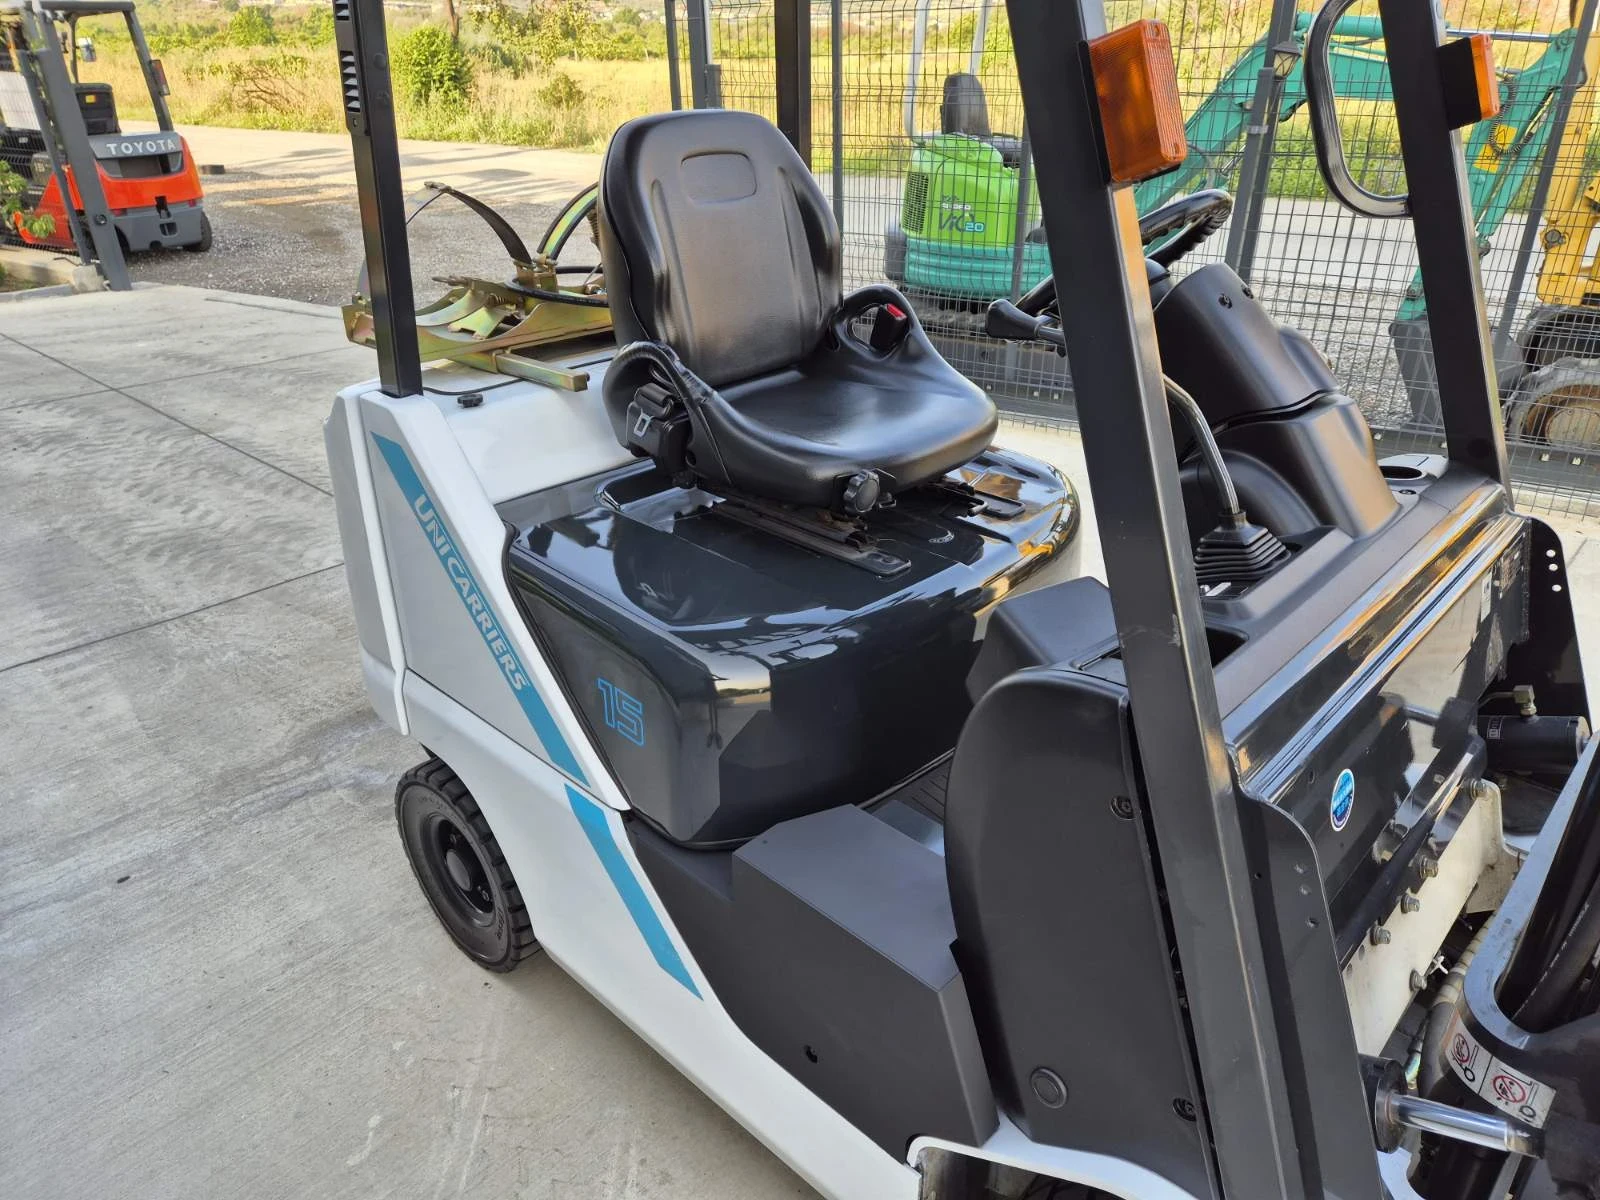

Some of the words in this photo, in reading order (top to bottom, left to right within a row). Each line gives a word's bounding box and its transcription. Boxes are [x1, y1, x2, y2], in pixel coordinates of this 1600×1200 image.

[106, 140, 176, 155] TOYOTA
[414, 494, 530, 691] UNICARRIERS
[596, 677, 645, 746] 15
